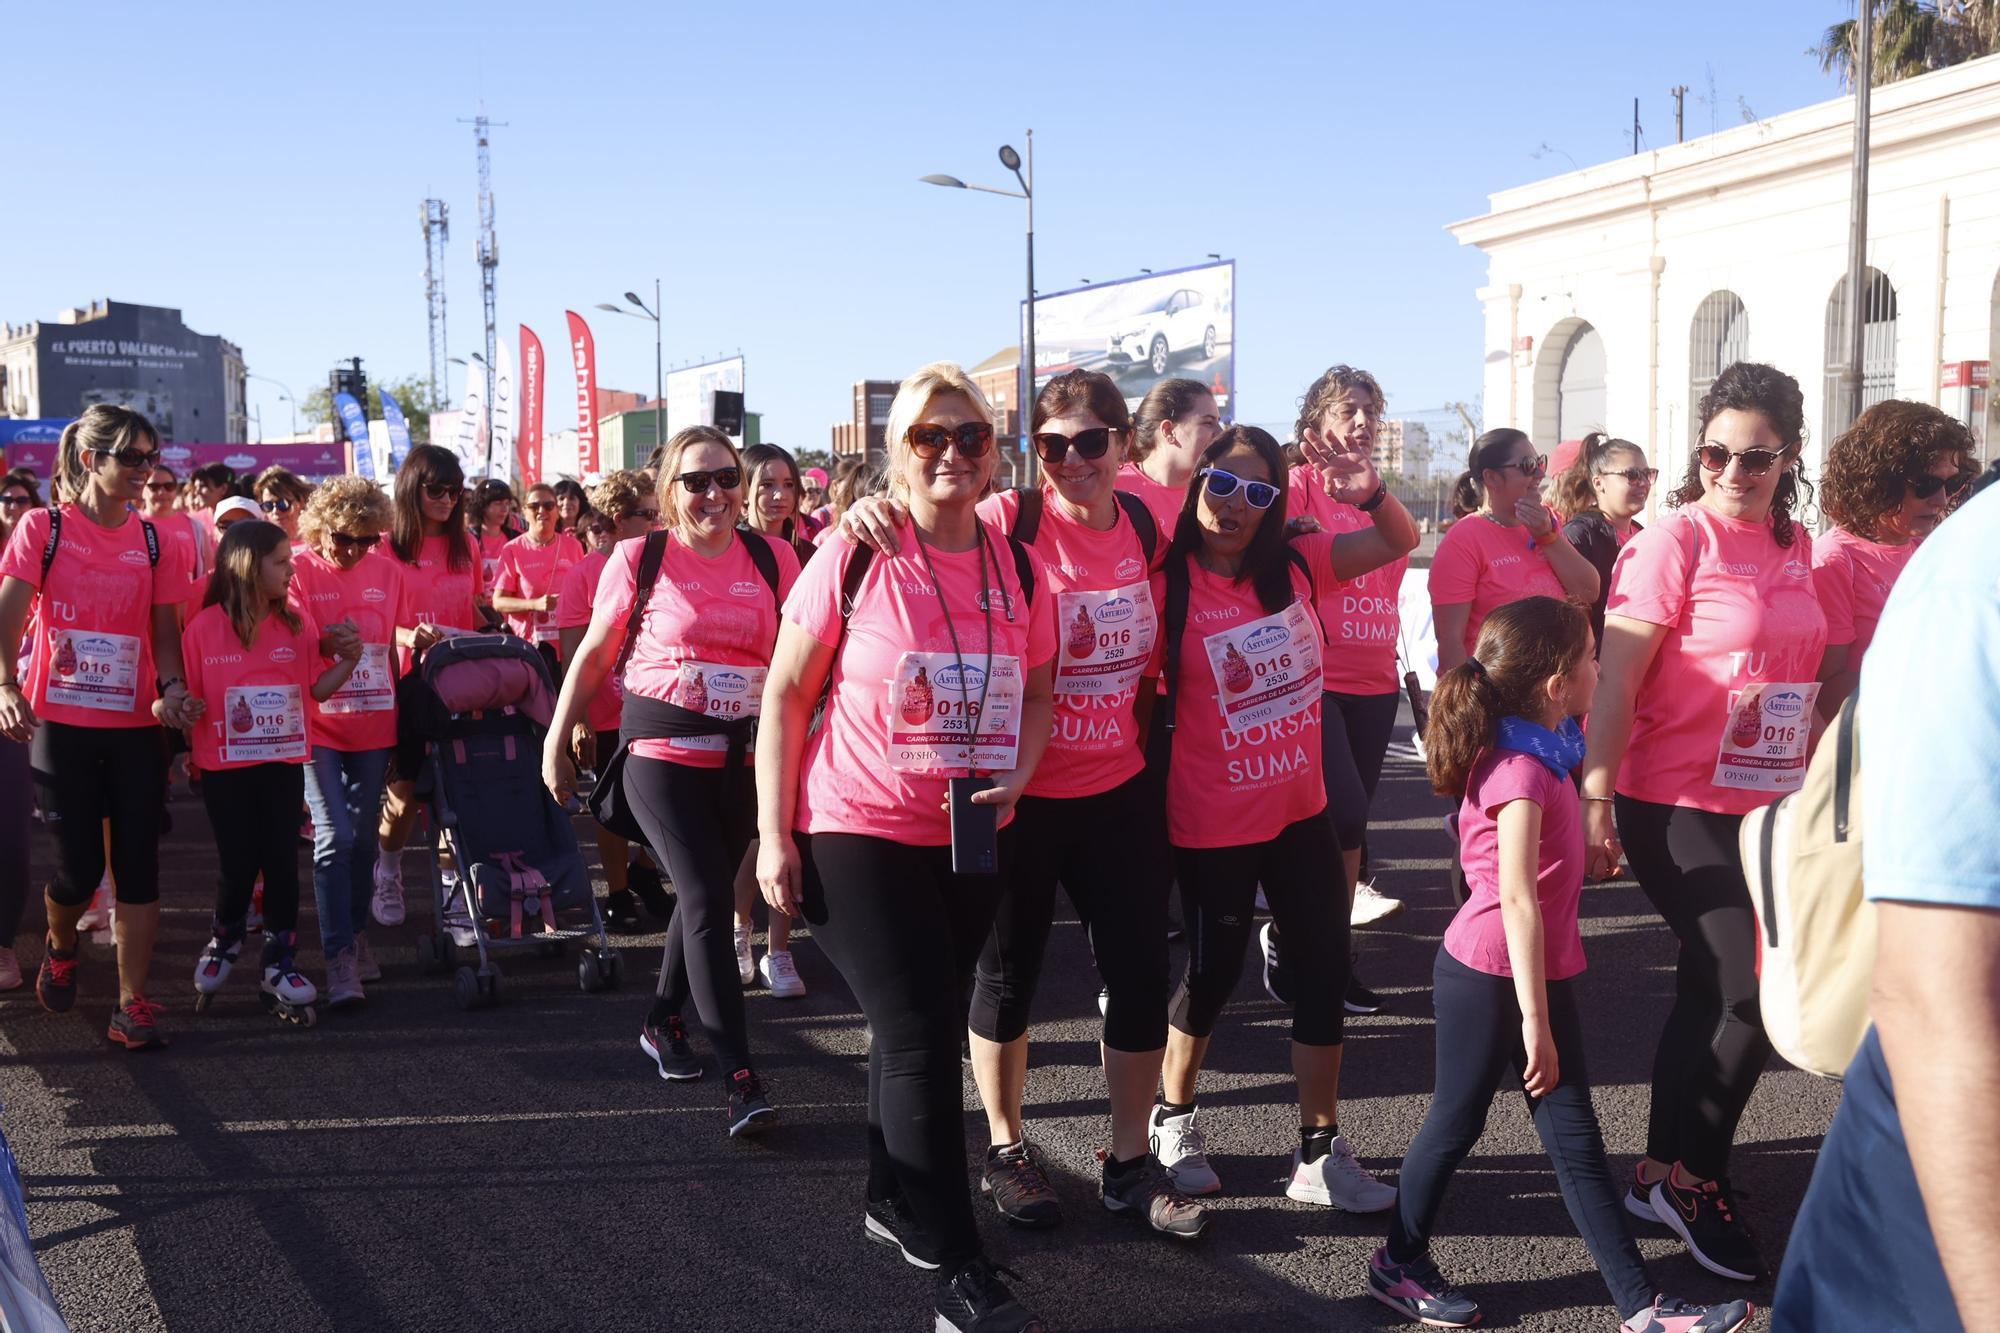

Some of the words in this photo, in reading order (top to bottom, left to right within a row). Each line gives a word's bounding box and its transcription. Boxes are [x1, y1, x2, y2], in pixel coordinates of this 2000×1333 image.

[68, 341, 116, 355] PUERTO
[52, 600, 76, 621] TU
[1195, 606, 1240, 624] OYSHO
[1342, 621, 1397, 641] SUMA
[1099, 629, 1131, 648] 016
[1247, 632, 1288, 652] ASTURIANA
[205, 655, 242, 665] OYSHO
[1105, 648, 1124, 660] 2529
[80, 661, 111, 674] 016
[1111, 663, 1119, 671] LA
[1254, 653, 1292, 677] 016
[1729, 651, 1765, 677] TU
[85, 675, 104, 683] 1022
[938, 674, 984, 685] ASTUIANA
[992, 670, 1014, 678] SUMA
[1265, 672, 1289, 688] 2530
[712, 679, 746, 688] ASTURIANA
[1067, 680, 1102, 689] OYSHO
[1237, 694, 1267, 709] CARRERA
[1268, 690, 1278, 699] DE
[1279, 688, 1287, 697] LA
[711, 698, 741, 712] 016
[937, 700, 980, 717] 016
[256, 714, 284, 726] 016
[1239, 707, 1272, 725] OYSHO
[943, 719, 969, 730] 2531
[262, 727, 280, 735] 1023
[1764, 726, 1796, 742] 016
[901, 751, 938, 760] OYSHO
[969, 751, 1008, 761] antander
[1766, 745, 1787, 755] 2031
[1228, 744, 1309, 783] SUMA
[1731, 757, 1762, 766] CARRERA
[1724, 771, 1759, 782] OYSHO
